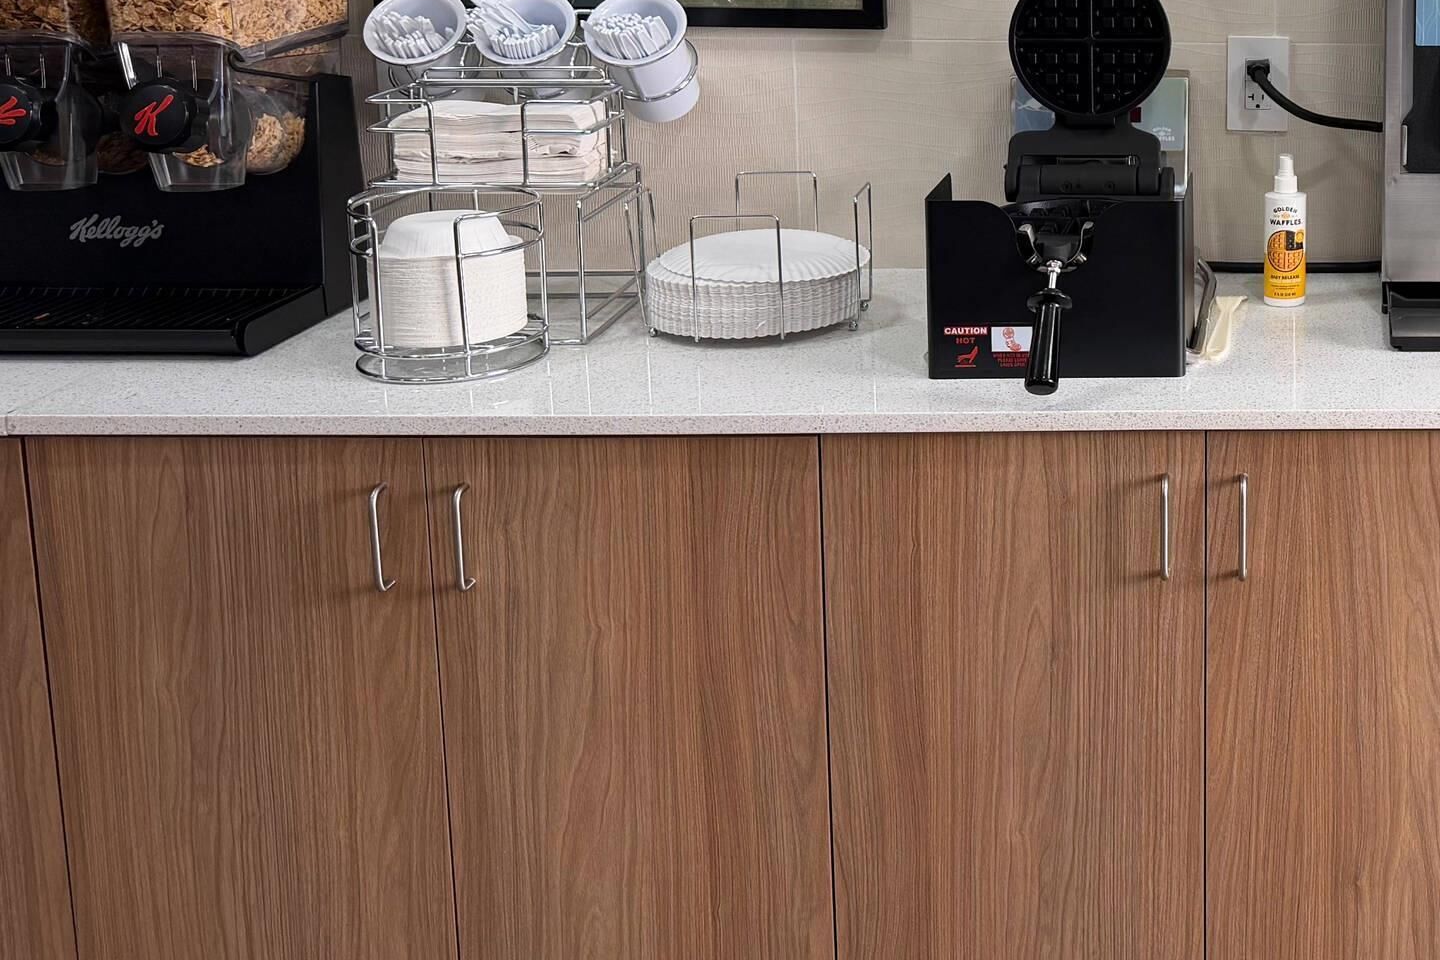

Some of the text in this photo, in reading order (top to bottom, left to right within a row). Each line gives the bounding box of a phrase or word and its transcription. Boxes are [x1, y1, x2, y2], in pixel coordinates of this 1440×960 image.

[1273, 206, 1298, 214] GOLDEN
[1270, 218, 1302, 226] WAFFLES
[69, 213, 165, 248] Kellogg's
[944, 326, 988, 335] CAUTION
